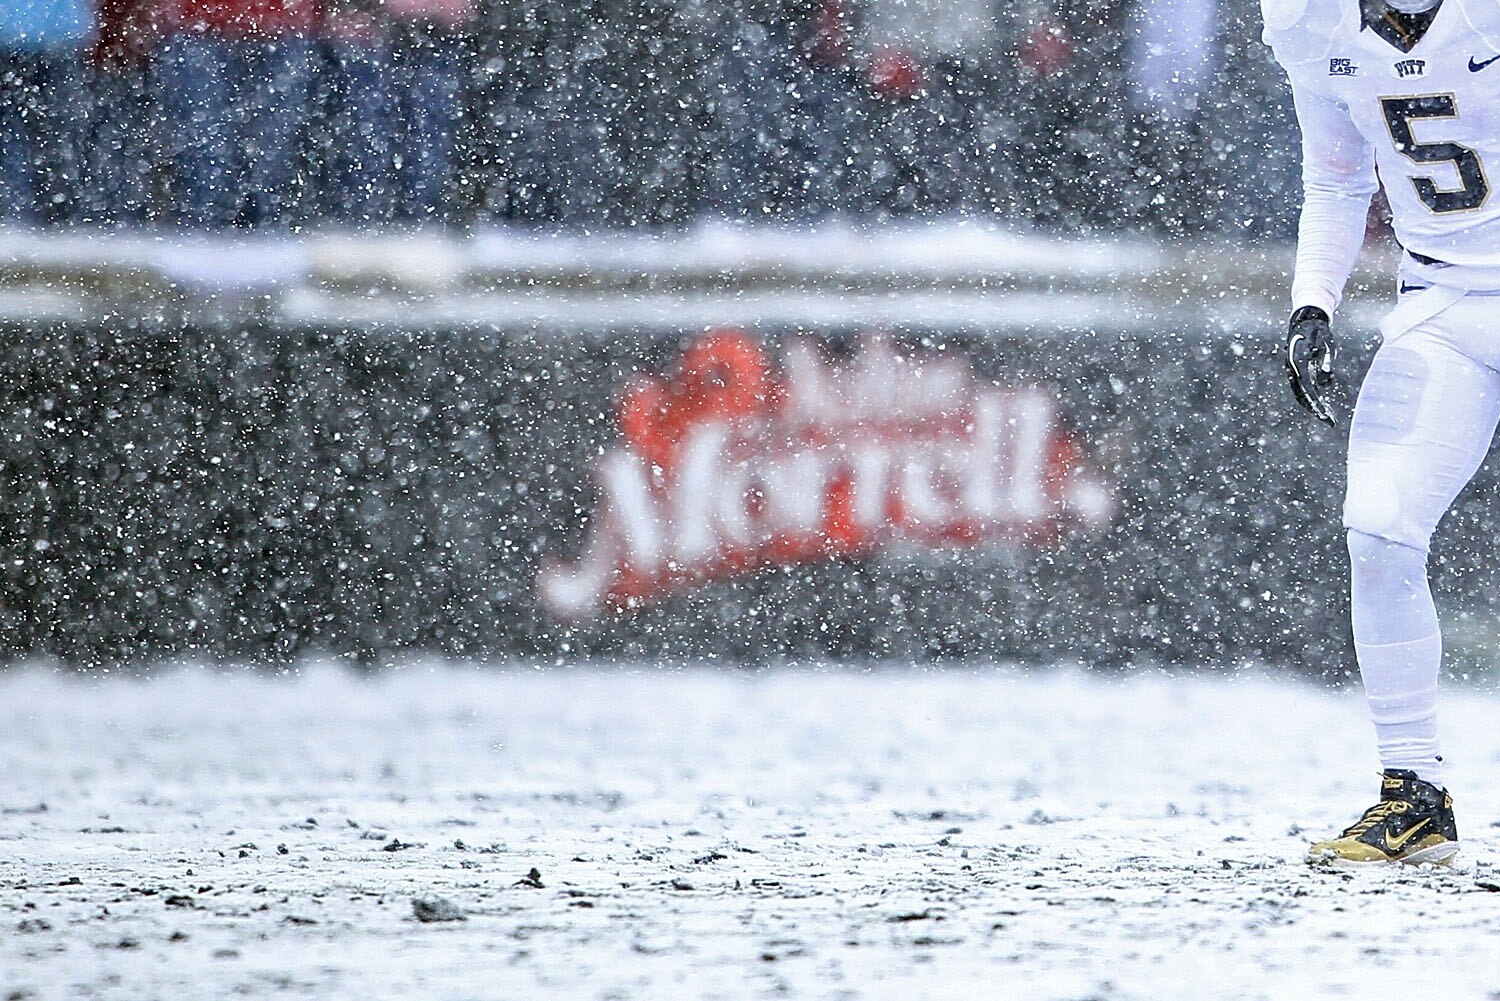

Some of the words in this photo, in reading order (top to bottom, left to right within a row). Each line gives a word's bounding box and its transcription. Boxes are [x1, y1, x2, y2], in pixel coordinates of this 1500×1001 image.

[1330, 58, 1351, 67] BIG
[1394, 59, 1426, 78] PITT
[1329, 66, 1358, 74] EAST
[1377, 92, 1492, 216] 5
